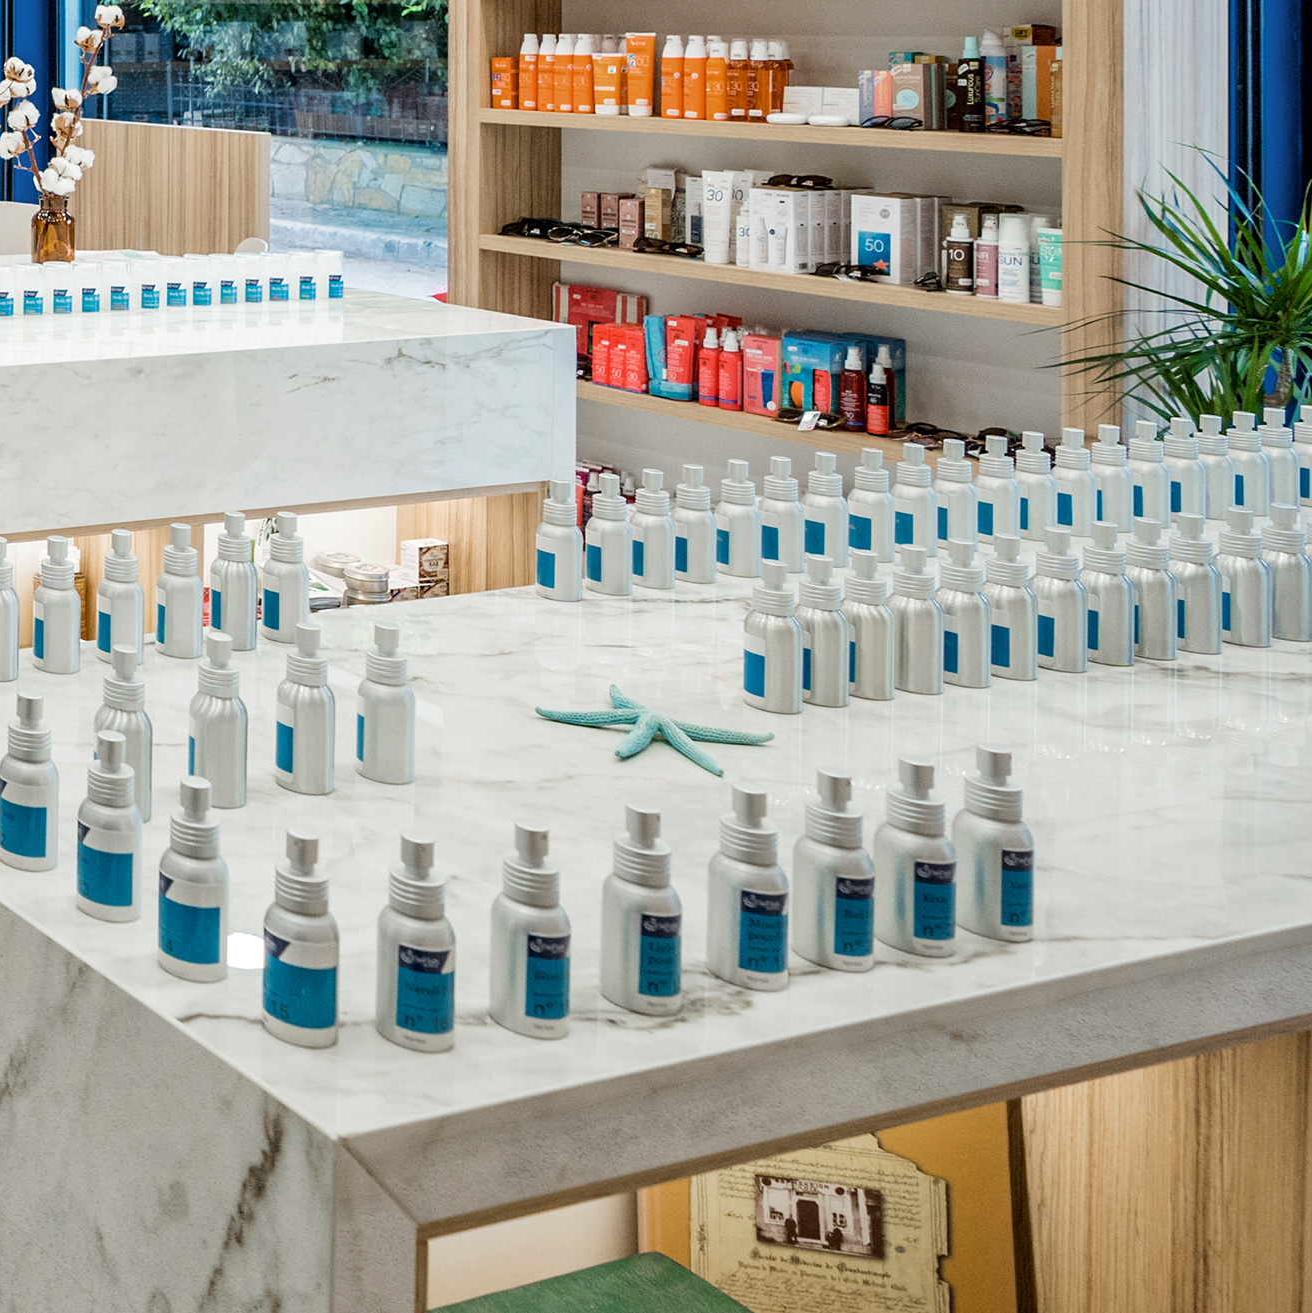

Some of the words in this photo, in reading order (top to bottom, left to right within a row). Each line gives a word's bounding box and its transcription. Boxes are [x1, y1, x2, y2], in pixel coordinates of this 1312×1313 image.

[706, 189, 724, 202] 30
[864, 239, 884, 253] 50
[948, 249, 965, 261] 10
[999, 256, 1023, 266] SUN
[627, 371, 638, 381] 30
[923, 893, 946, 902] Eros
[405, 981, 441, 998] Neroli
